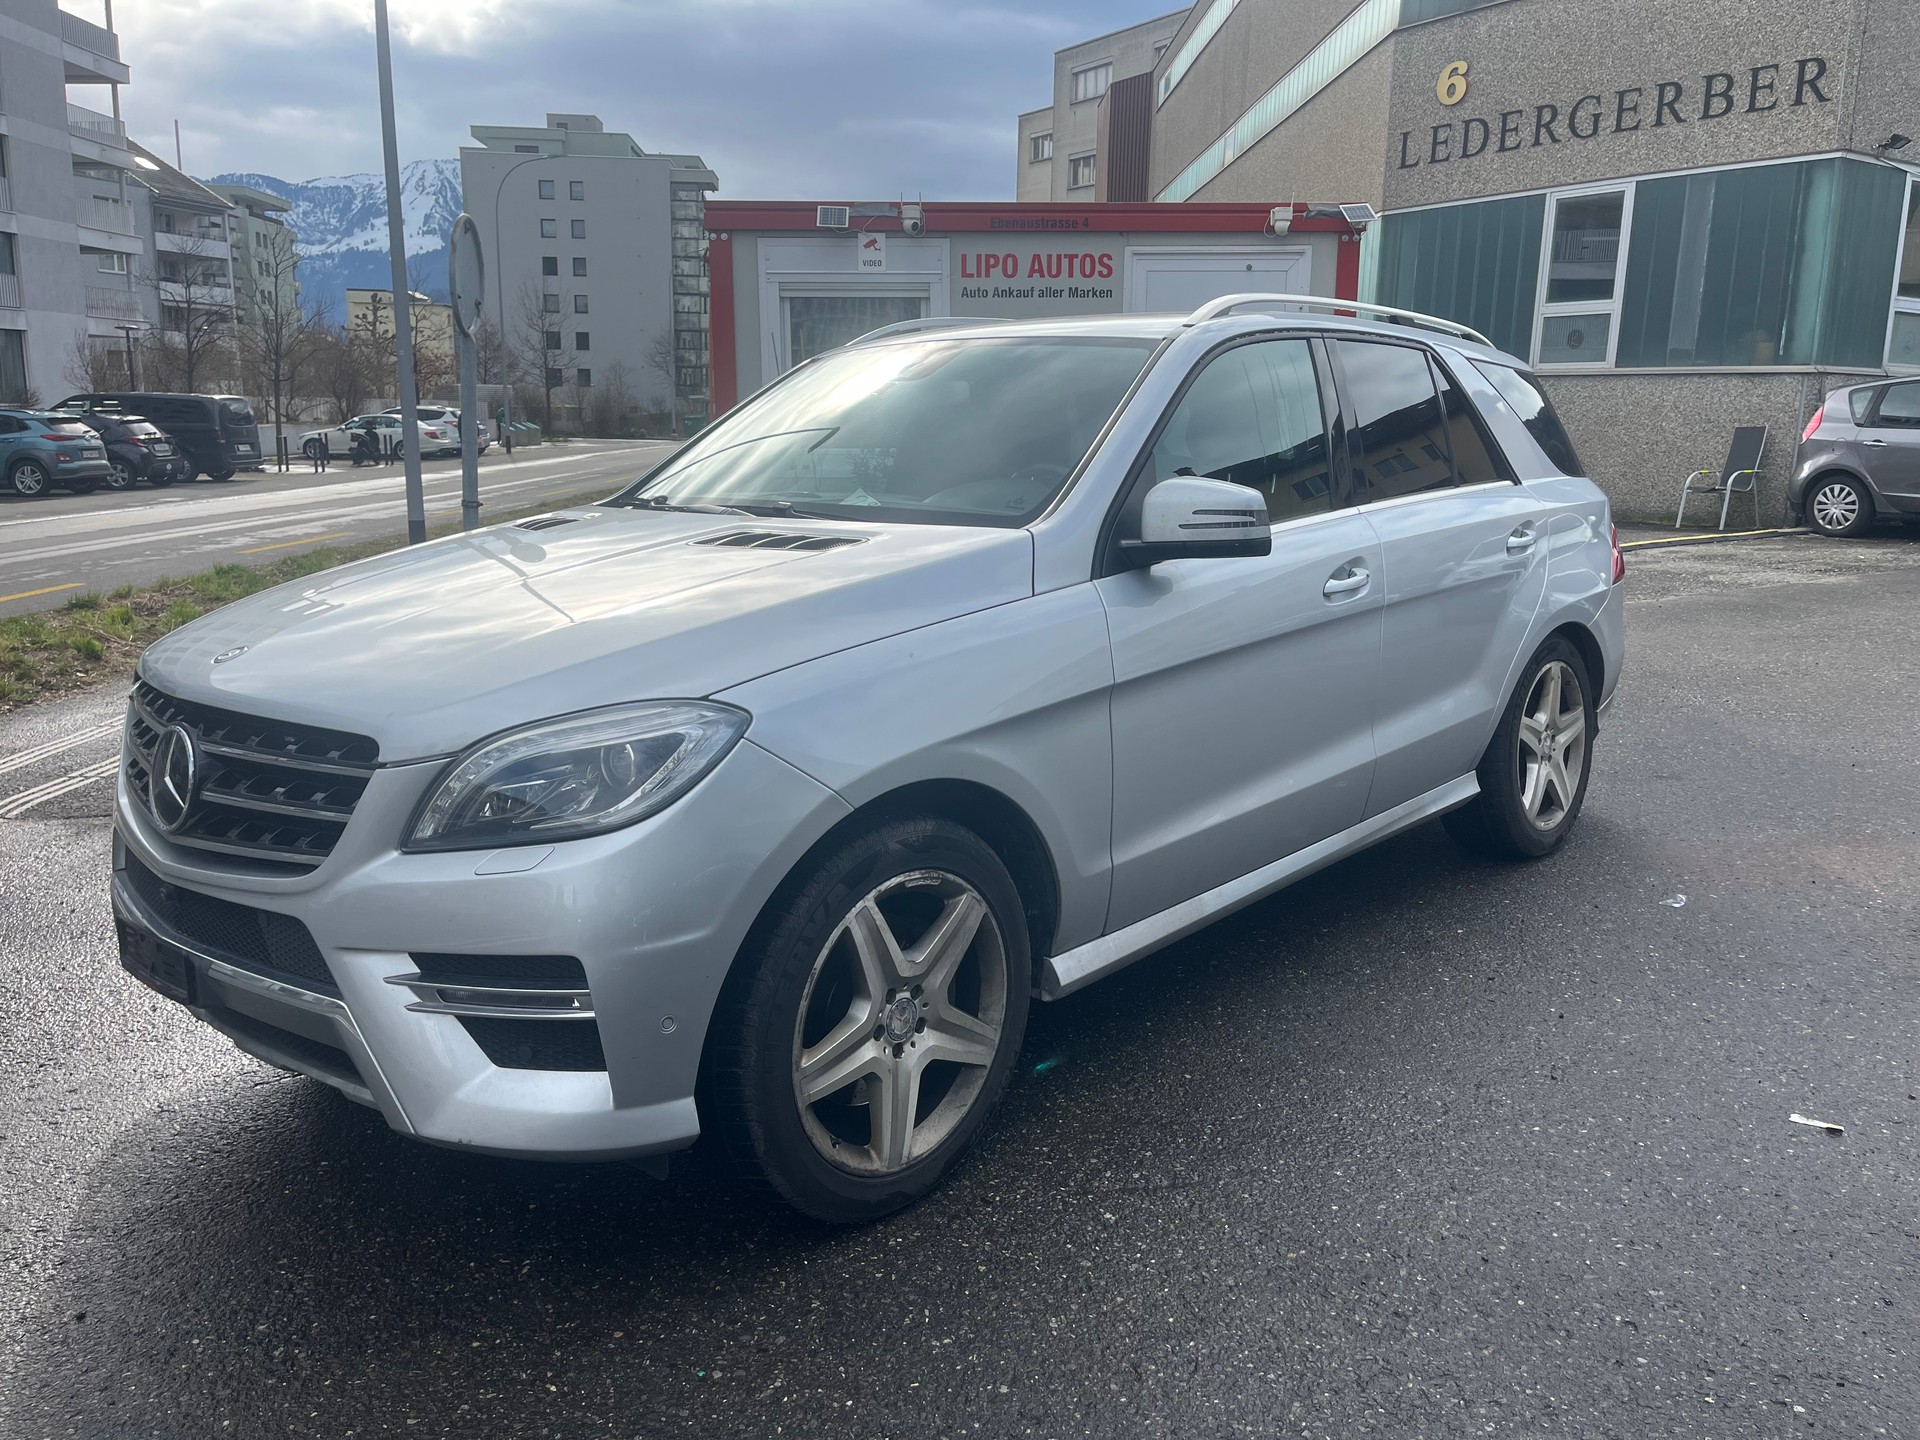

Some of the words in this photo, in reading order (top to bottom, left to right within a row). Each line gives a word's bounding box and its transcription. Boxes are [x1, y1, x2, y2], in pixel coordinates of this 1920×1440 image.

[1436, 60, 1468, 106] 6
[1397, 57, 1831, 170] LEDERGERBER
[991, 217, 1078, 229] Ebenaustrasse
[1082, 217, 1089, 229] 4
[862, 259, 882, 267] VIDEO
[960, 253, 1019, 279] LIPO
[1027, 253, 1114, 279] AUTOS
[961, 287, 989, 298] Auto
[992, 286, 1035, 298] Ankauf
[1038, 286, 1064, 298] aller
[1068, 286, 1113, 298] Marken
